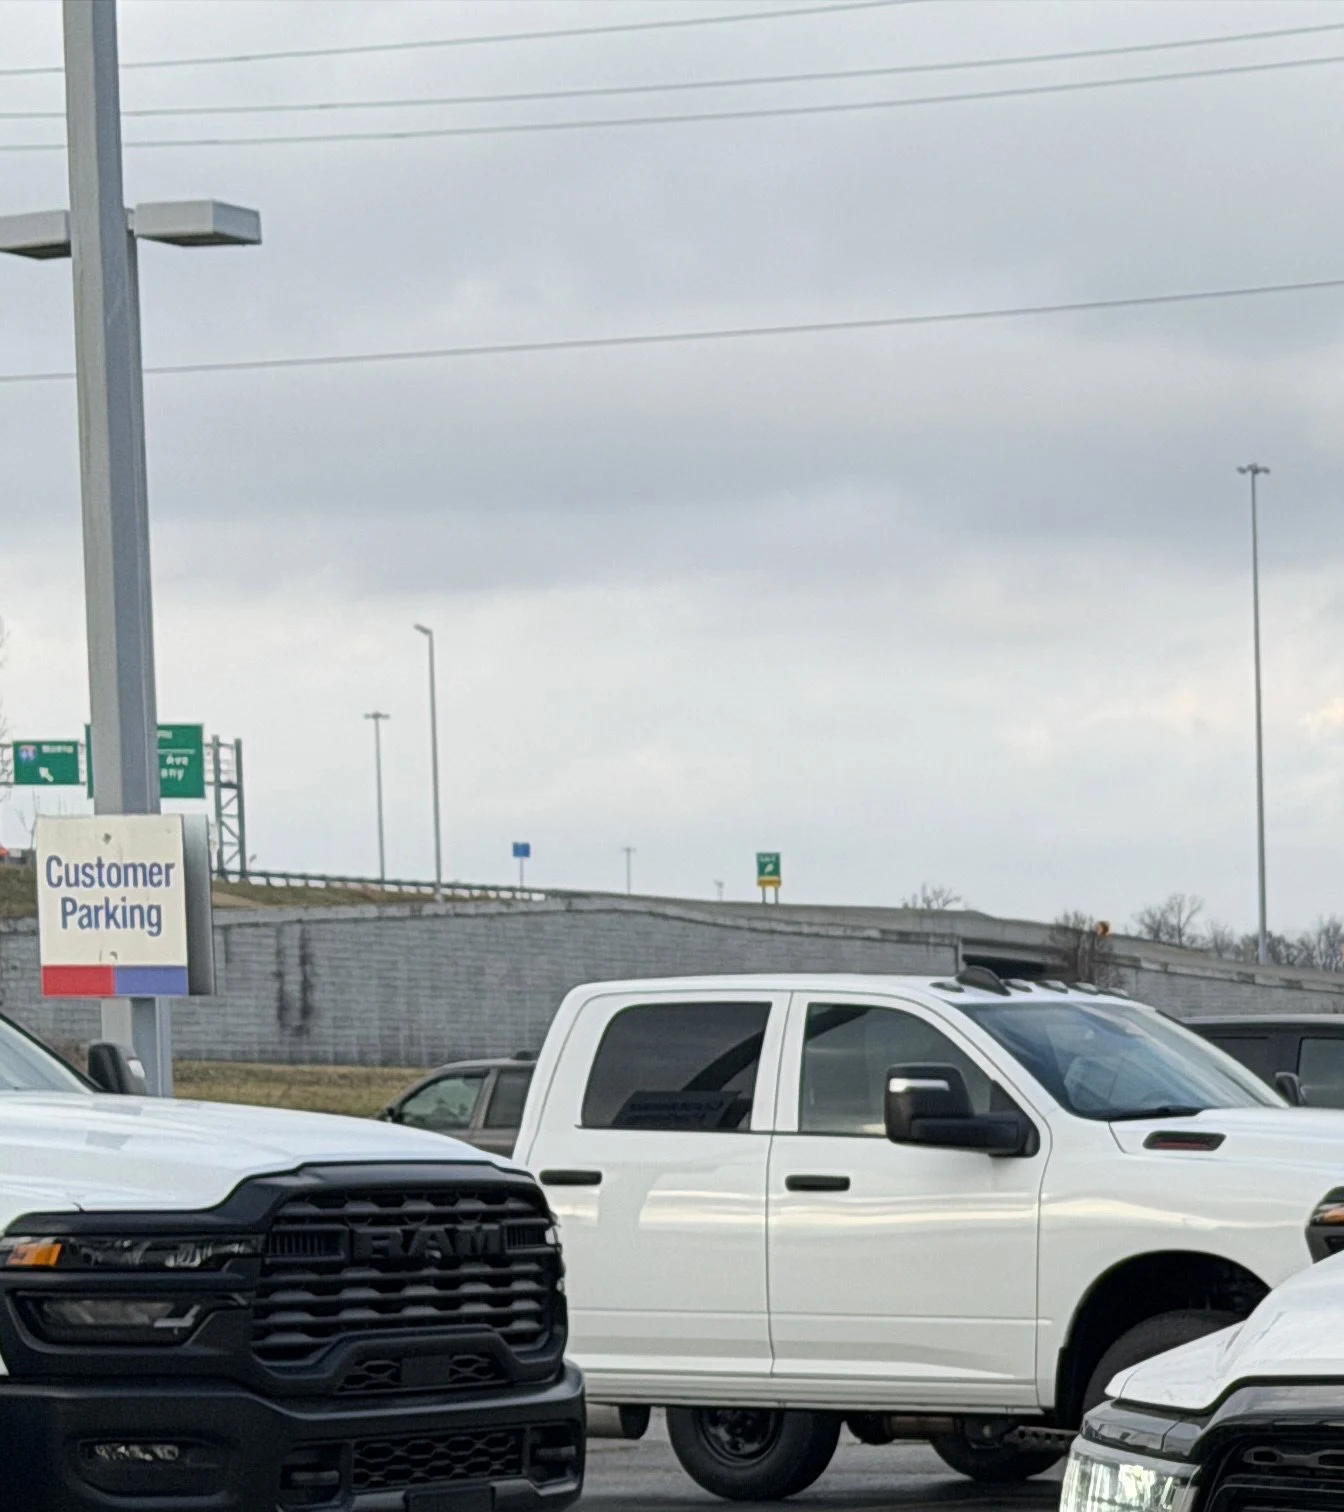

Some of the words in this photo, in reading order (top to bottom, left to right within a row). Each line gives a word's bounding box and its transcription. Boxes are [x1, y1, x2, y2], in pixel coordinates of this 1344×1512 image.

[46, 855, 175, 888] Customer
[60, 897, 162, 936] Parking
[350, 1224, 501, 1260] RAM
